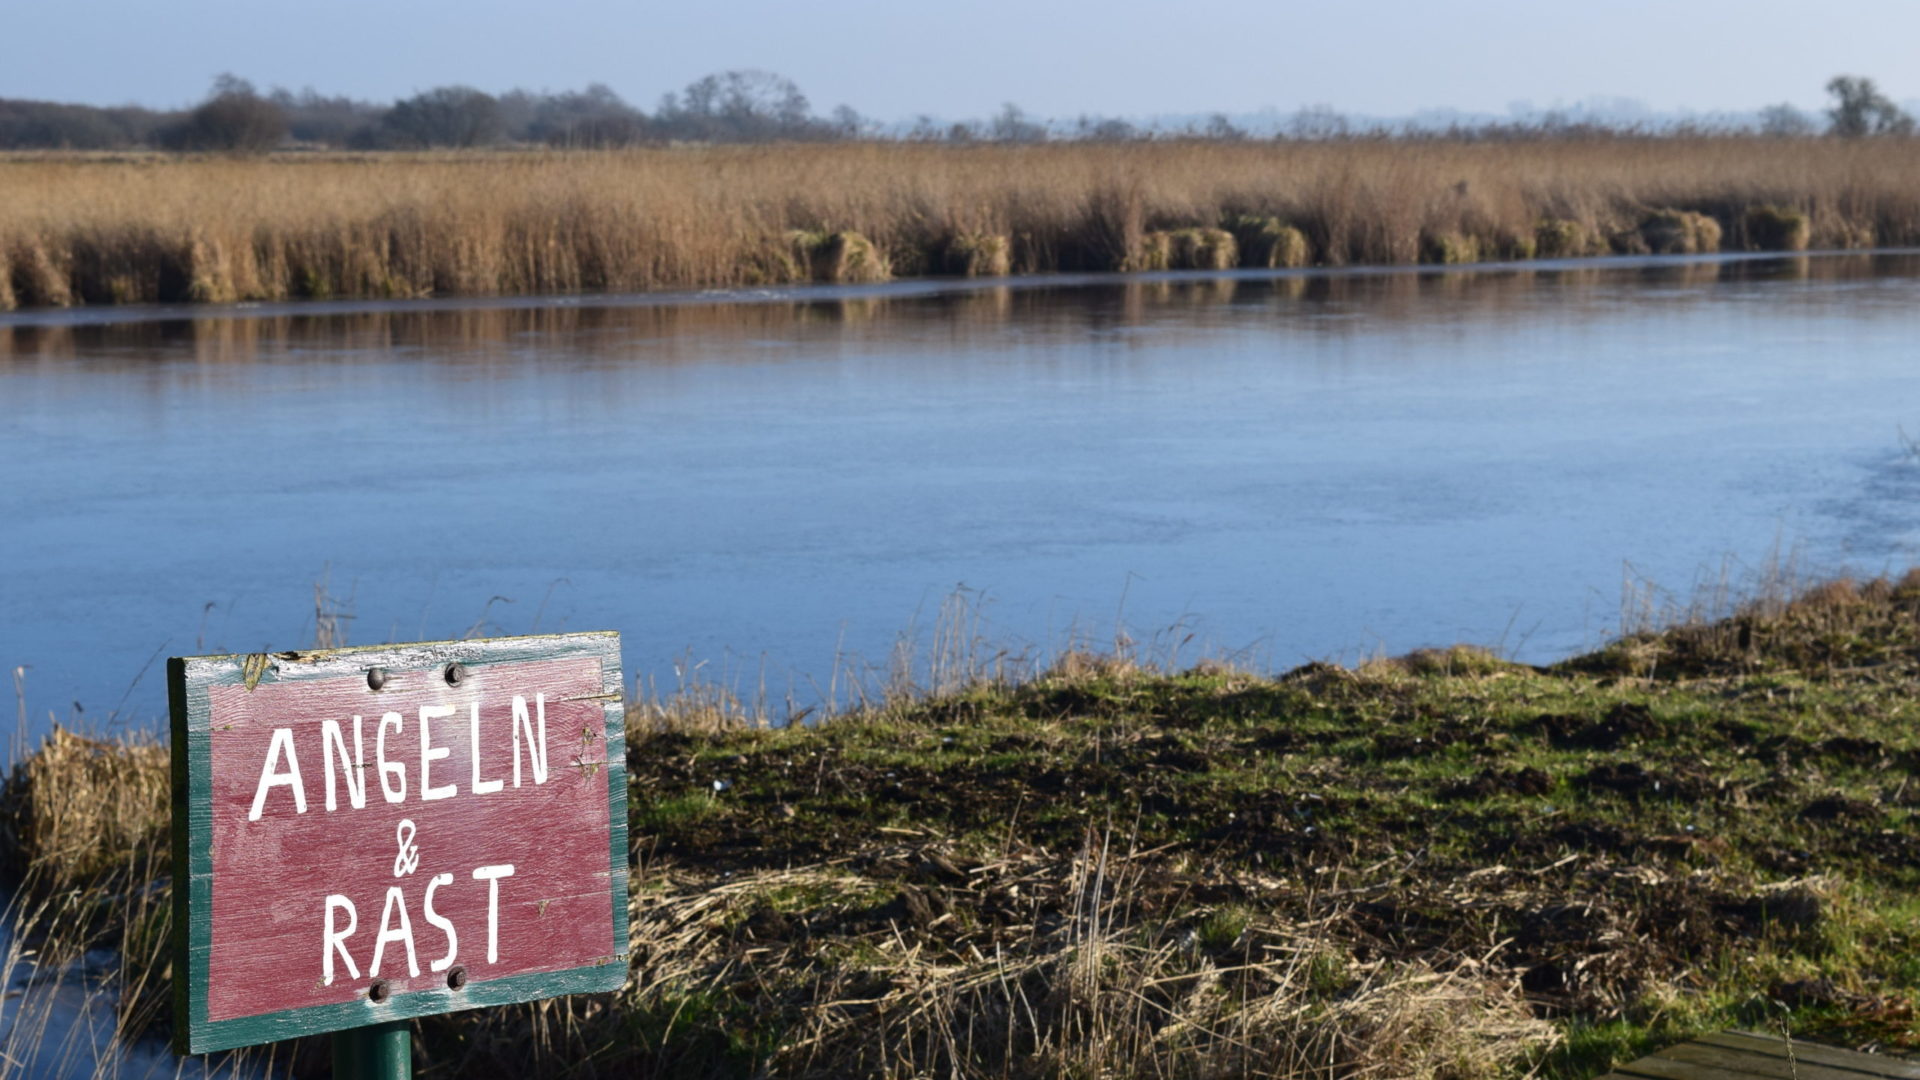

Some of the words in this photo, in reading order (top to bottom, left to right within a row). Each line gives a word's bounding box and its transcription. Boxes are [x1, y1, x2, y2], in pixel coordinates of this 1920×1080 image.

[249, 692, 548, 822] ANGELN
[393, 818, 420, 878] &
[322, 863, 515, 987] RAST
